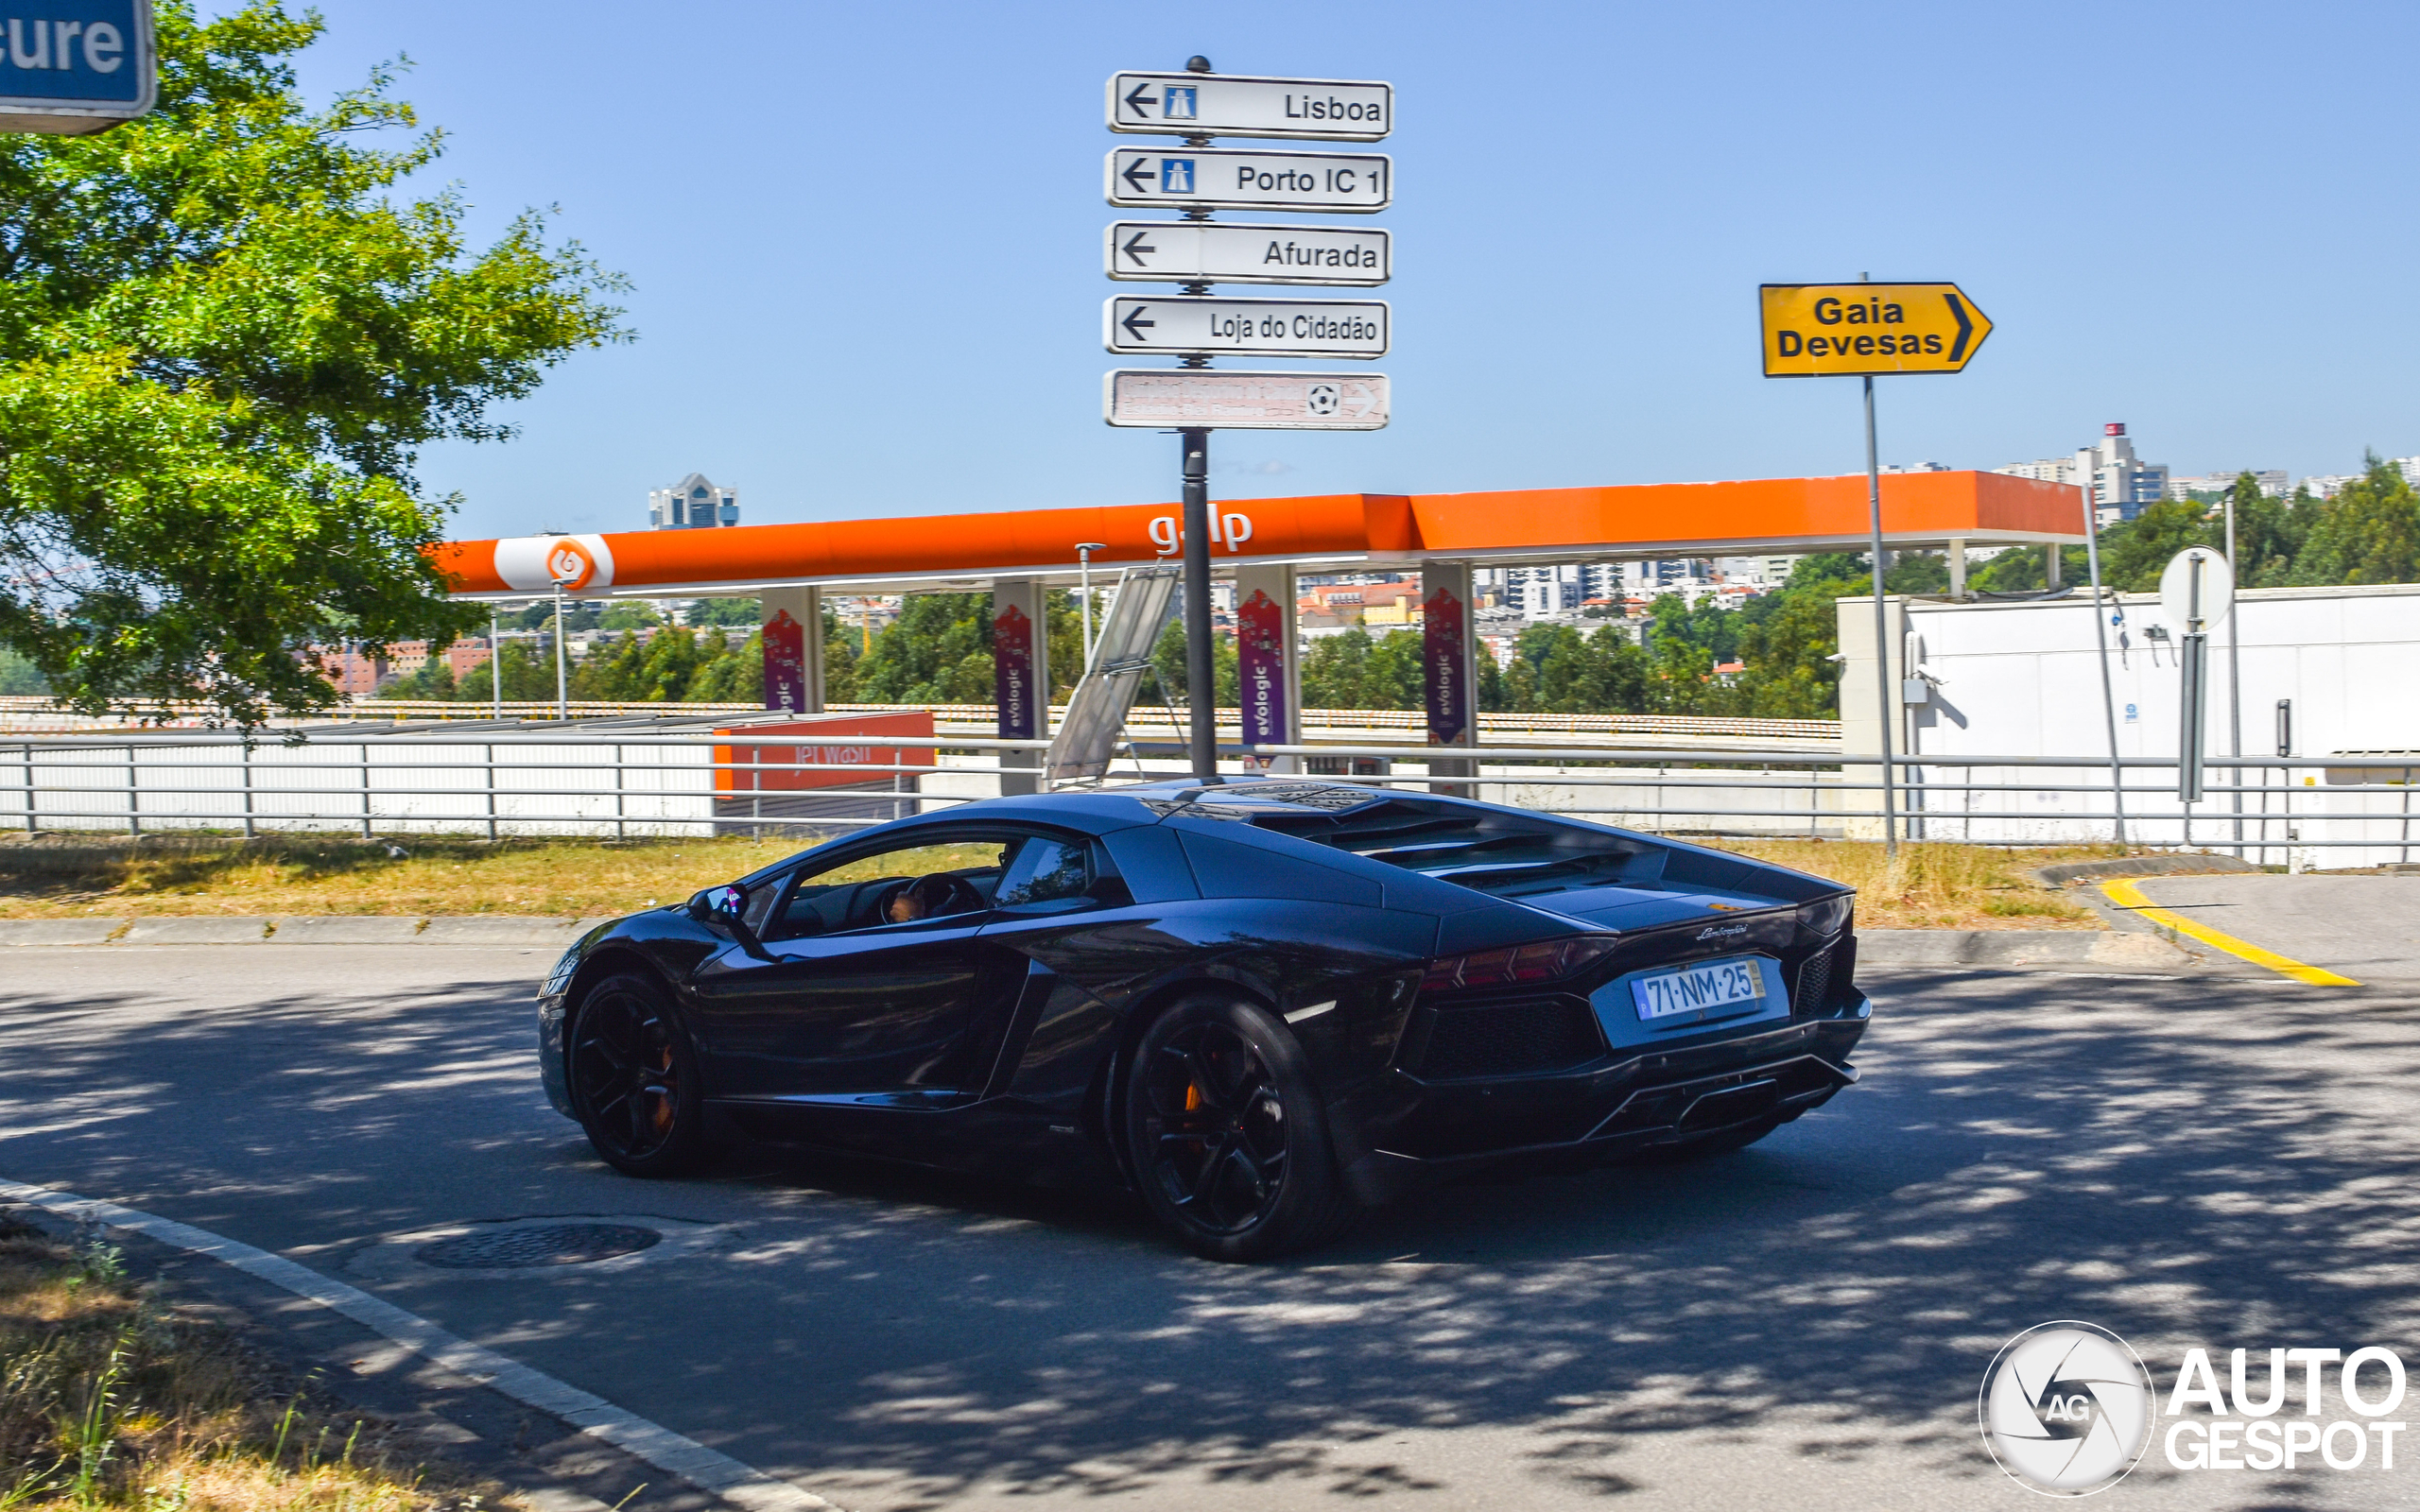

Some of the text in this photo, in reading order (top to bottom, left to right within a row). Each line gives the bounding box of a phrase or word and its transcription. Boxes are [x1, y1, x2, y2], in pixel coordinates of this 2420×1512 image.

[0, 18, 124, 74] ure
[1286, 94, 1381, 122] Lisboa
[1237, 165, 1378, 194] Porto IC 1
[1263, 240, 1377, 268] Afurada
[1814, 297, 1904, 325] Gaia
[1211, 313, 1376, 343] Loja do Cidadão
[1778, 330, 1943, 357] Devesas
[1148, 503, 1253, 556] glp
[1007, 668, 1024, 727] evologic
[1437, 655, 1454, 715] evologic
[1253, 666, 1272, 736] evologic
